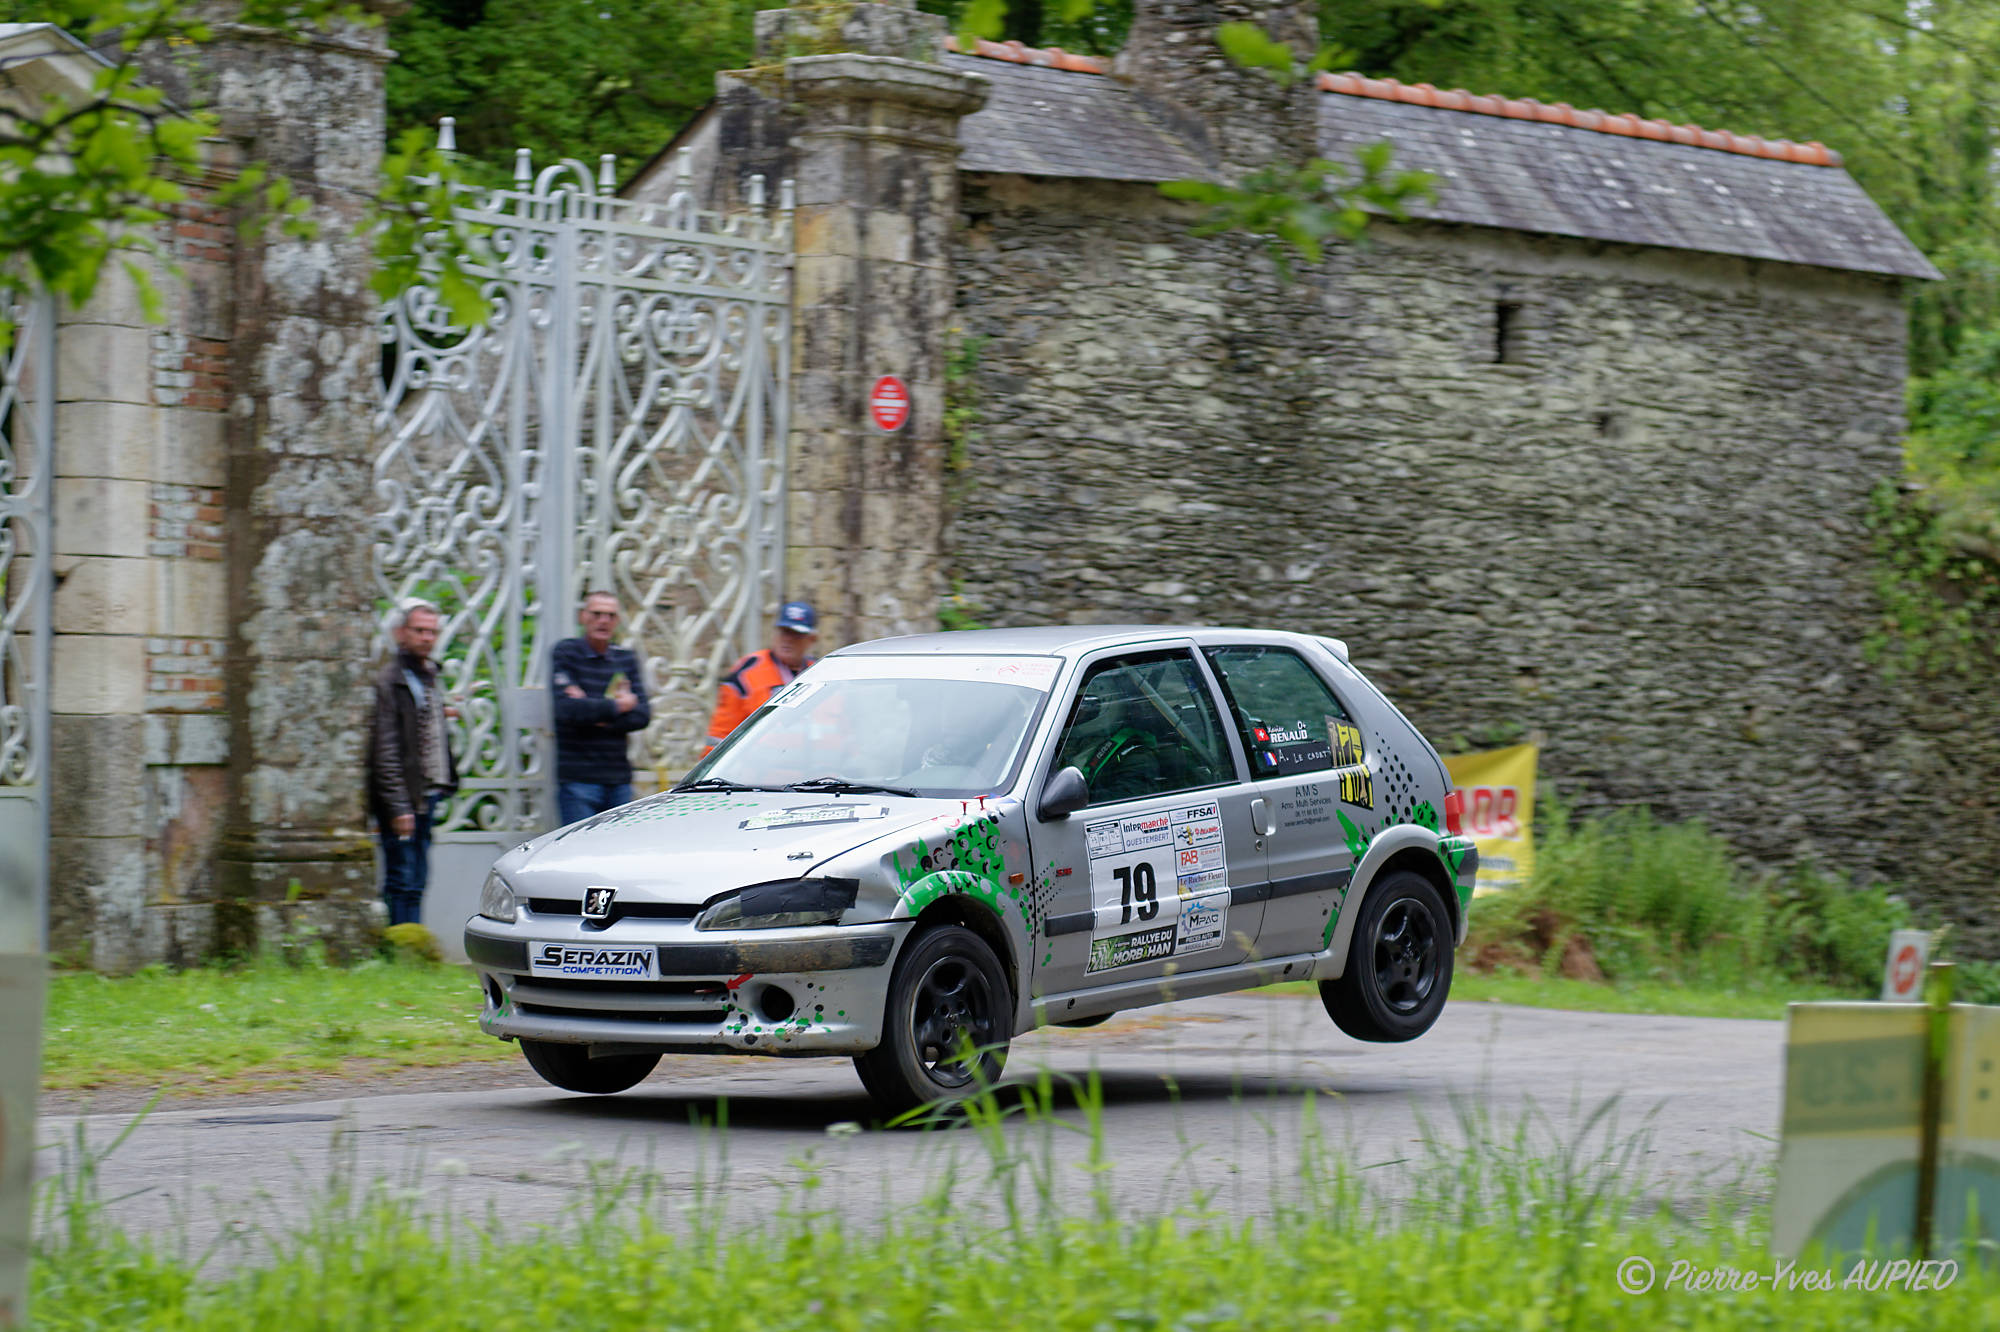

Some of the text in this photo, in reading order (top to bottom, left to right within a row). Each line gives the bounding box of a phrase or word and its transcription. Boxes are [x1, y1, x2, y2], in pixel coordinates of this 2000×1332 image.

[1270, 729, 1308, 744] RENAUD
[1186, 806, 1213, 819] FFSA
[1126, 832, 1169, 847] QUESTEMBERT
[1181, 850, 1198, 867] FAB
[1113, 862, 1159, 926] 79
[1131, 932, 1160, 947] RALLYE
[1160, 929, 1173, 941] DU
[535, 946, 653, 973] SERAZIN
[562, 965, 644, 976] COMPETITION
